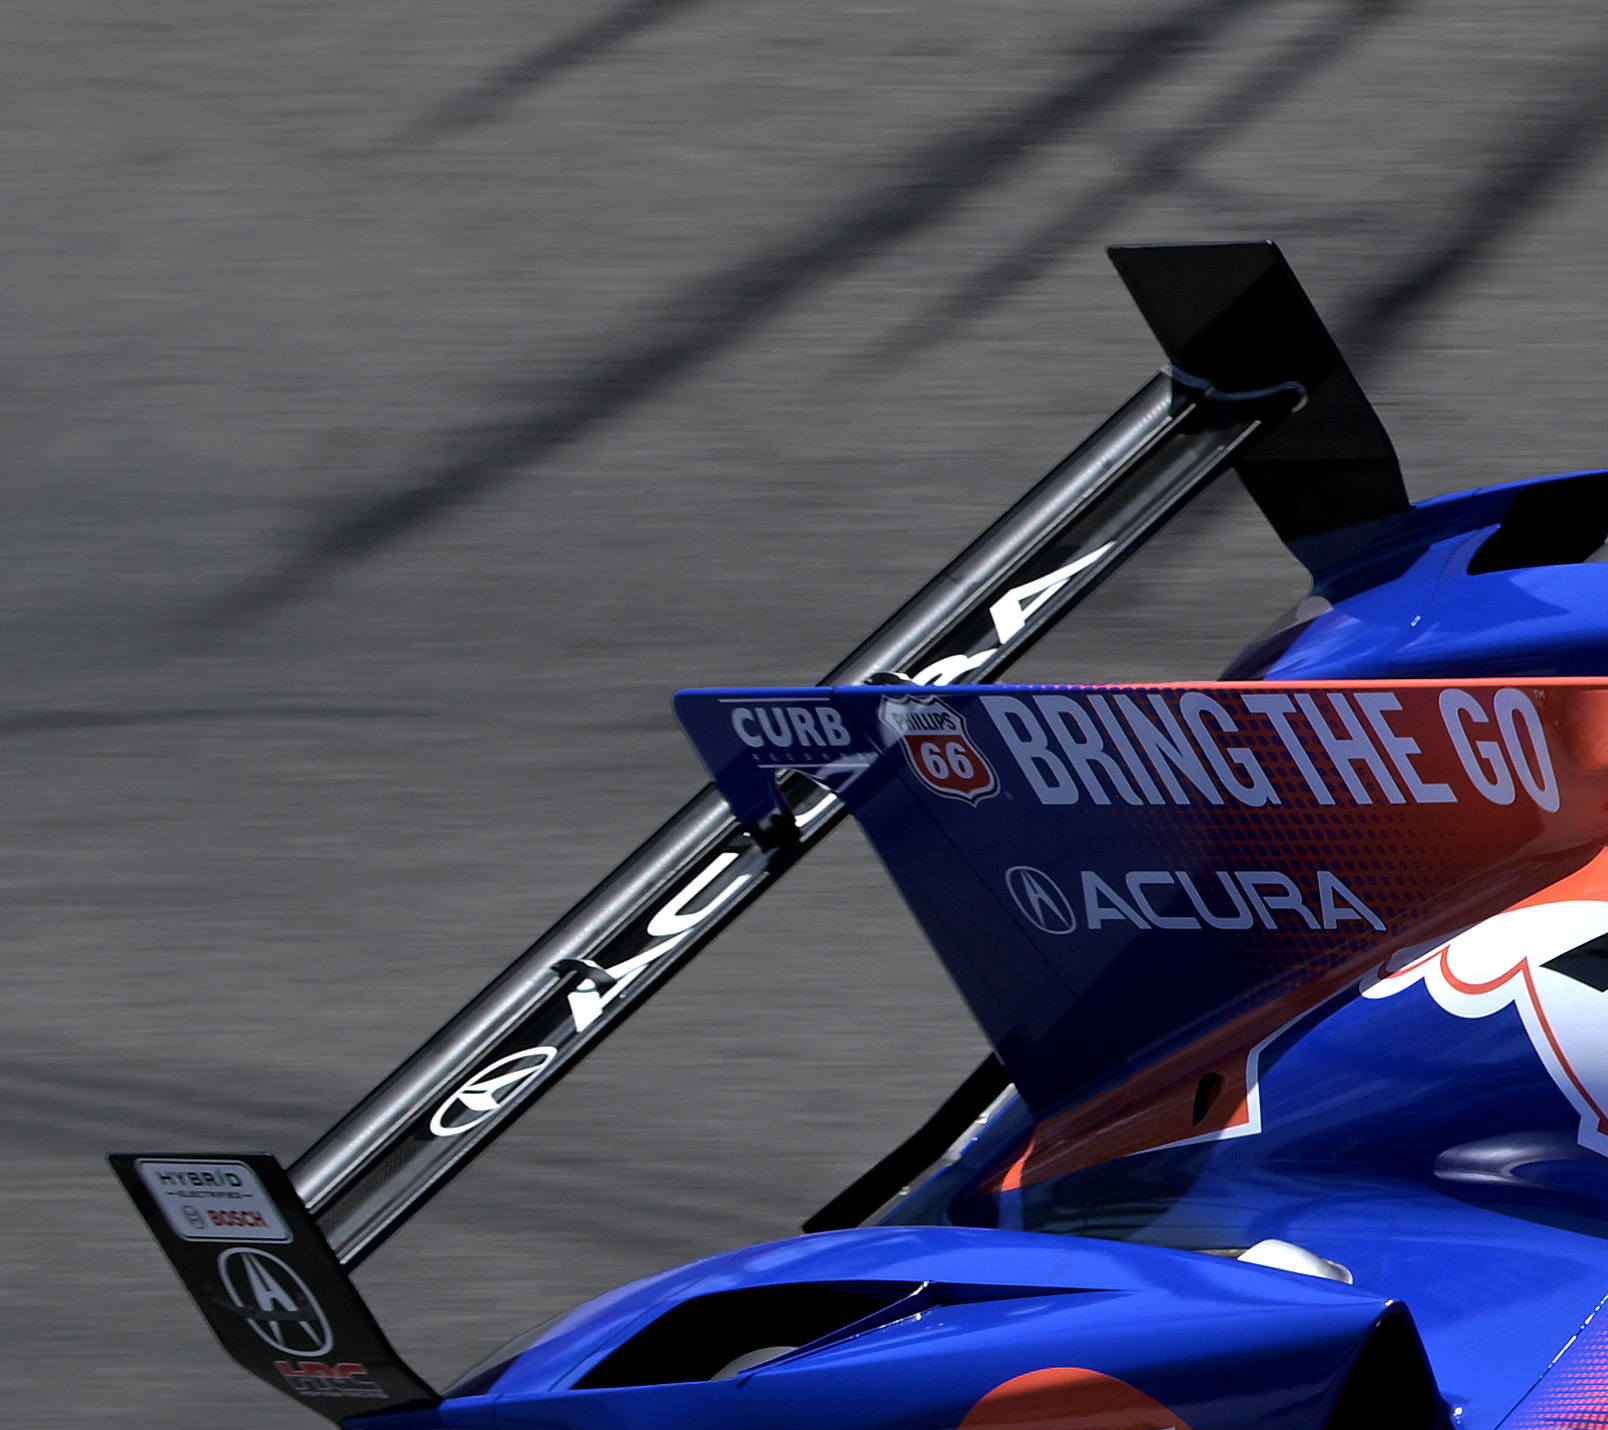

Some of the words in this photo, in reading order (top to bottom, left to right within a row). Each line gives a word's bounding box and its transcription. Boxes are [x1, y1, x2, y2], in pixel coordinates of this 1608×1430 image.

[731, 706, 851, 748] CURB
[892, 711, 957, 731] PHILLIPS
[921, 741, 979, 780] 66
[980, 691, 1282, 808] BRING
[1247, 691, 1459, 805] THE
[1438, 688, 1561, 813] GO
[1080, 870, 1387, 932] ACURA
[156, 1170, 243, 1188] HYBRID
[206, 1210, 269, 1228] BOSCH
